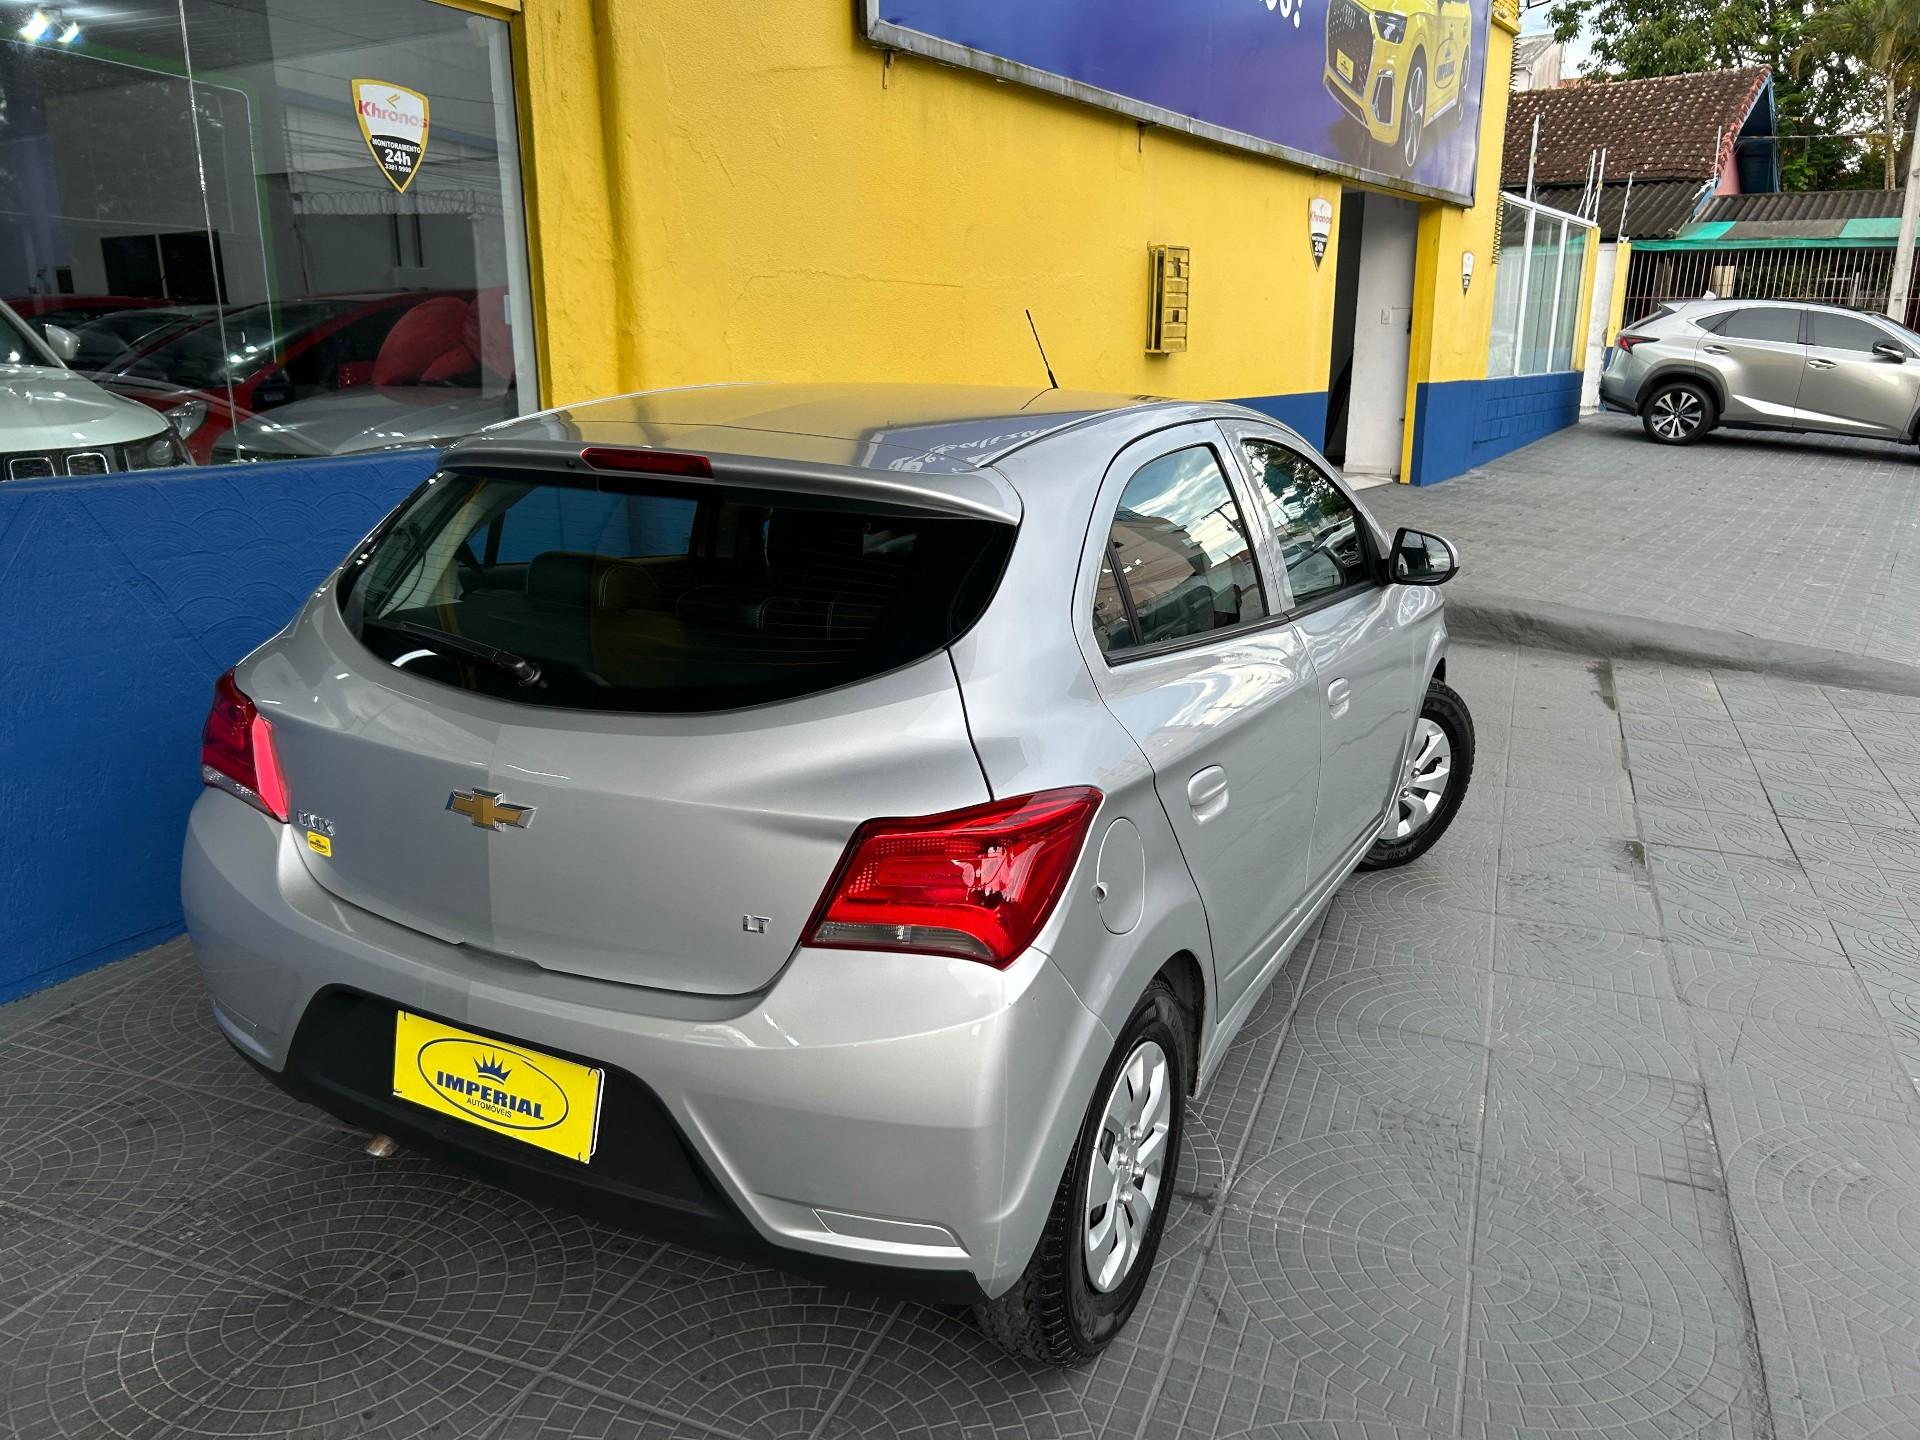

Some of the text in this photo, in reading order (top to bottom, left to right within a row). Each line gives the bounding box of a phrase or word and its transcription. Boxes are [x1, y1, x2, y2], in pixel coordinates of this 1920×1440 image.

[358, 100, 428, 129] Khronos
[372, 138, 421, 154] MONITORAMENTO
[385, 149, 411, 166] 24h
[743, 914, 772, 934] LT
[436, 1070, 545, 1121] IMPERIAL
